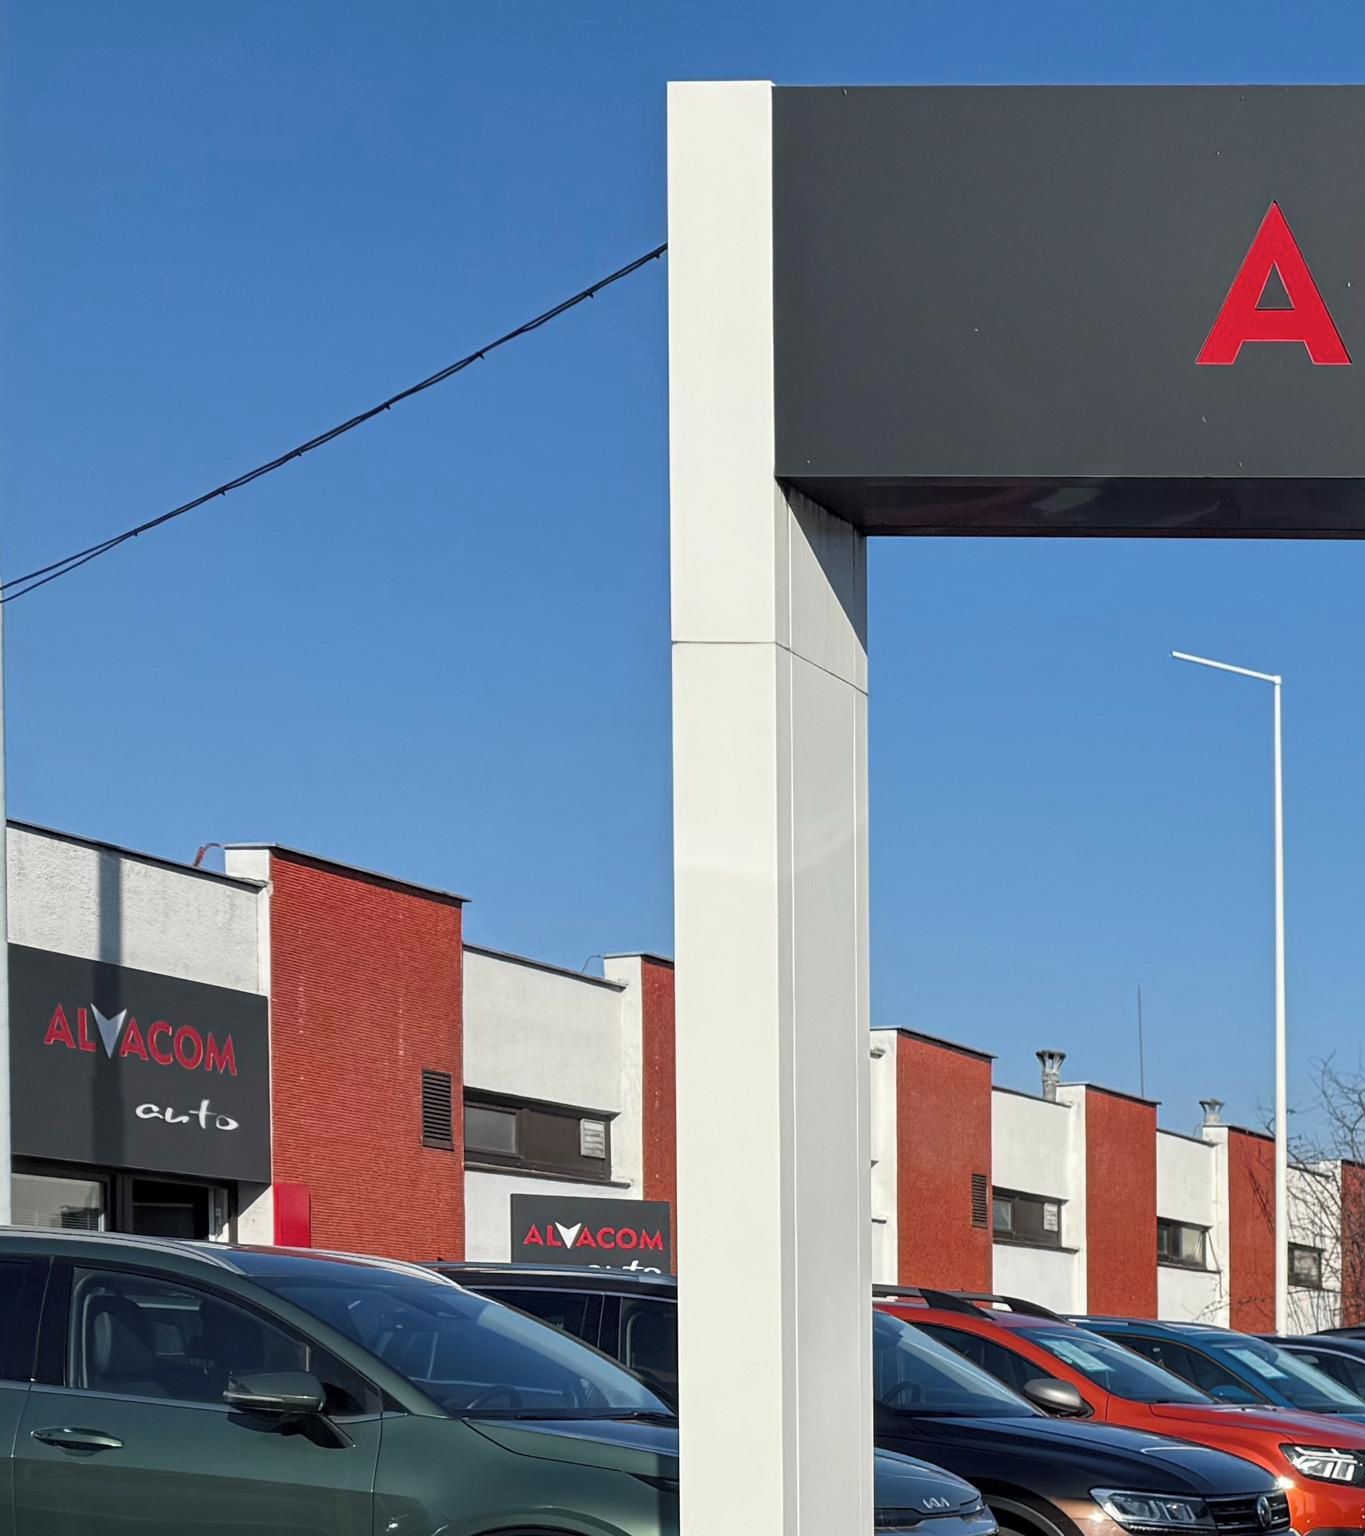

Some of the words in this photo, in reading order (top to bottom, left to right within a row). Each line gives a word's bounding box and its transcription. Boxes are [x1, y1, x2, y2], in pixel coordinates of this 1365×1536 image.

[43, 1002, 238, 1077] ALVACOM
[136, 1099, 240, 1132] auto
[522, 1221, 665, 1251] ALVACOM
